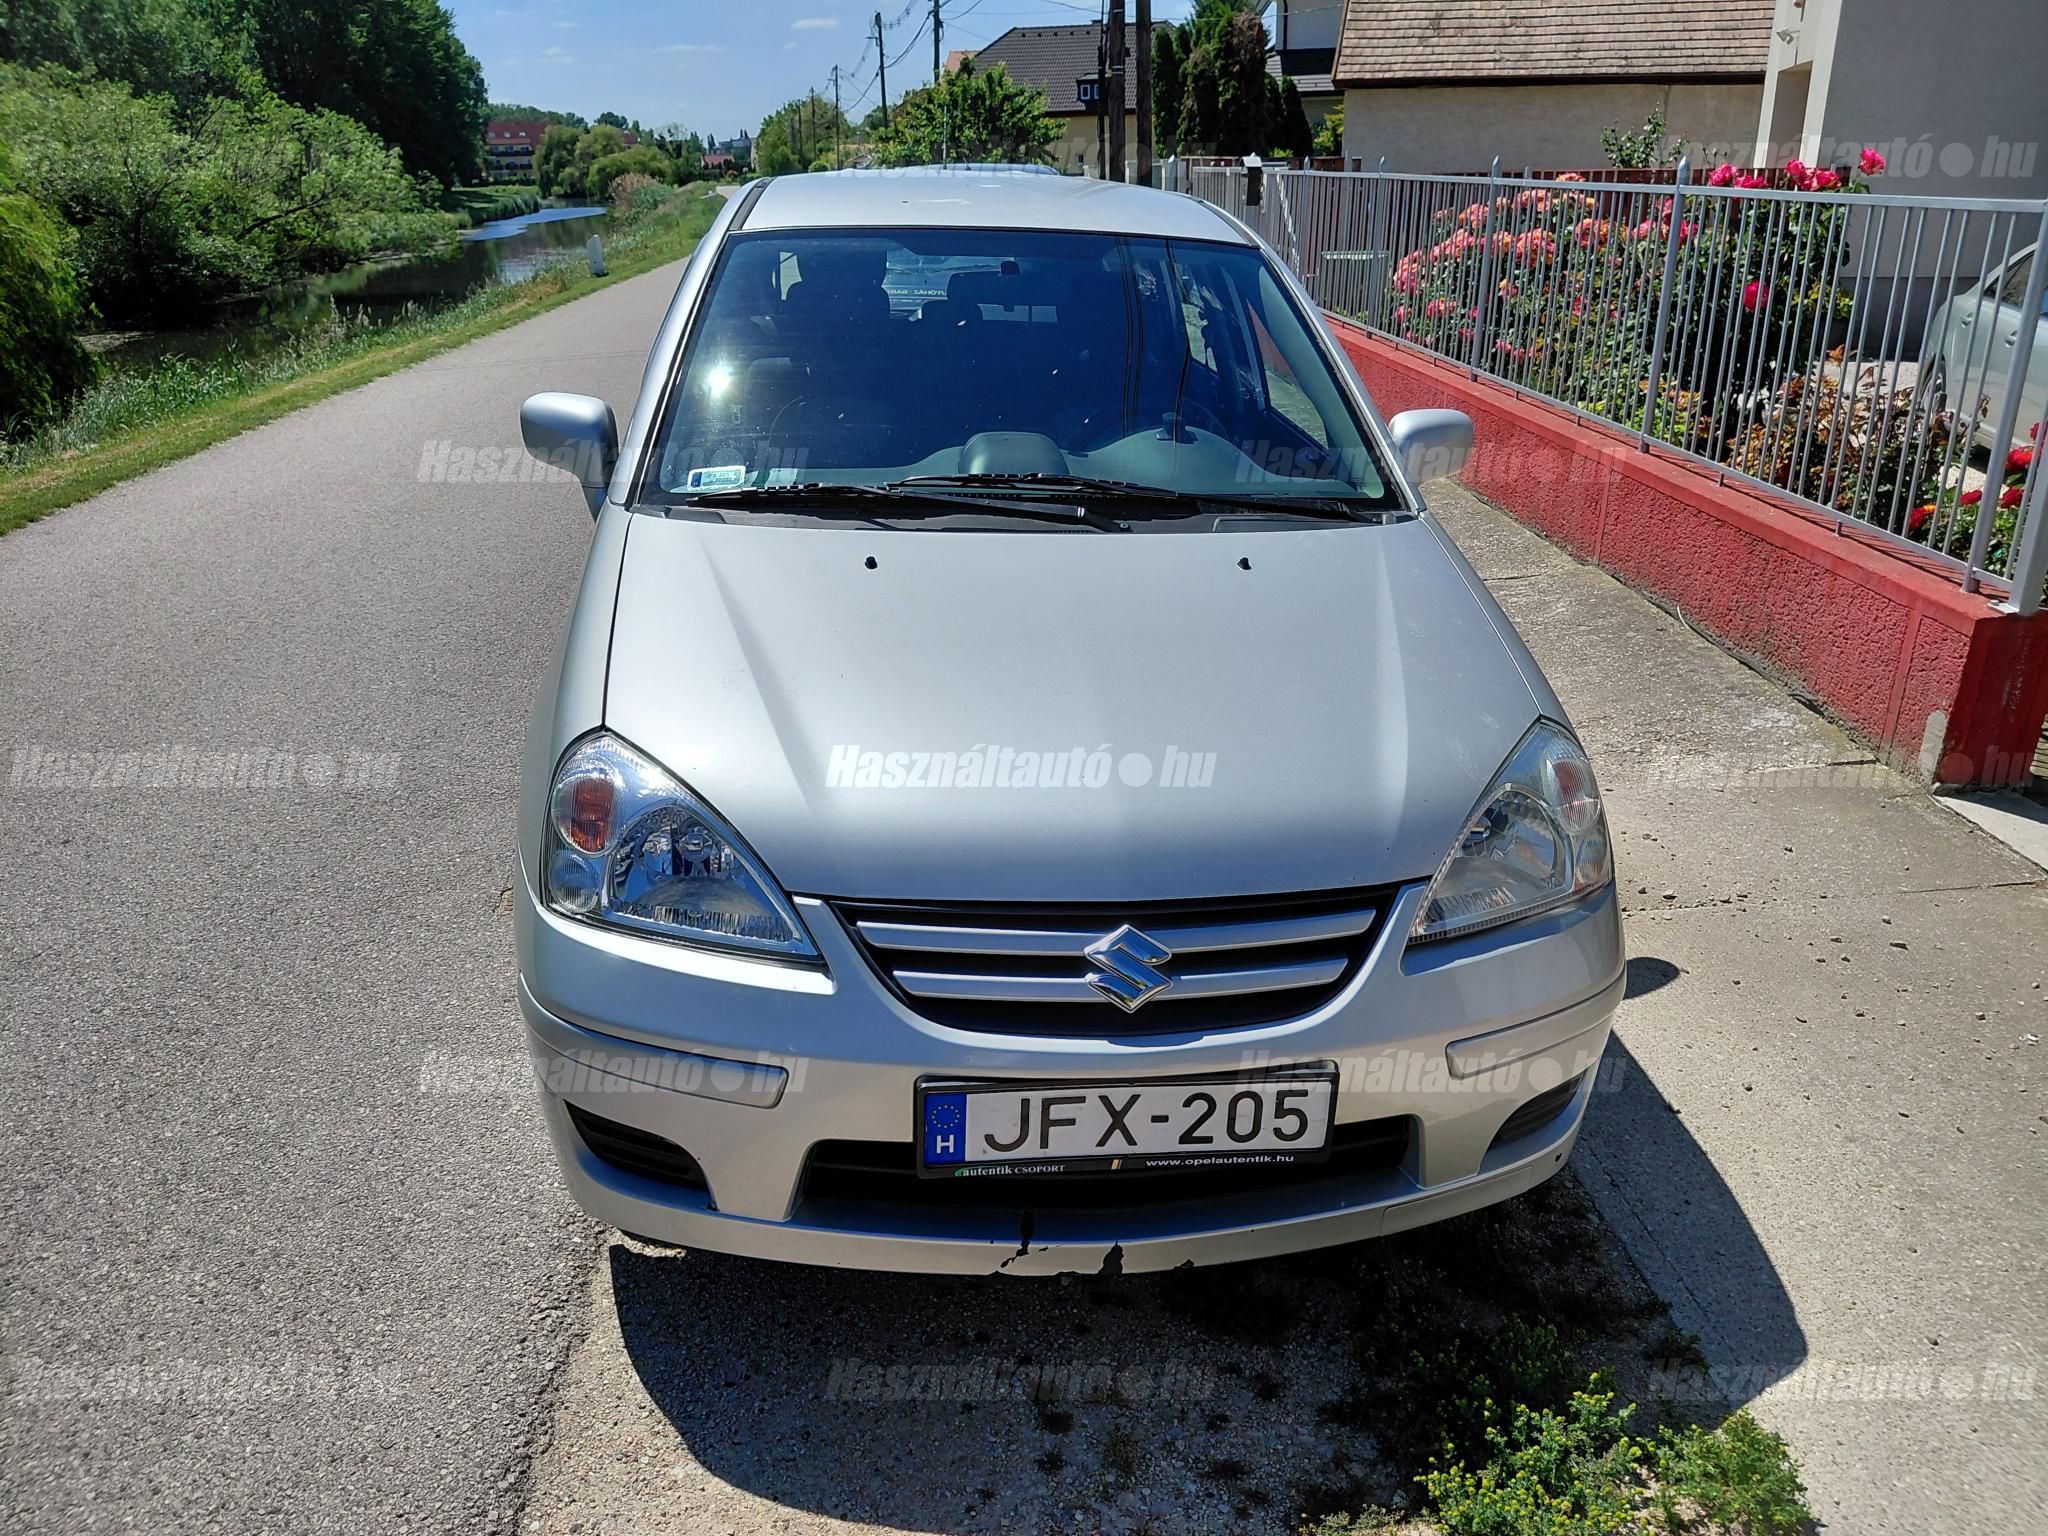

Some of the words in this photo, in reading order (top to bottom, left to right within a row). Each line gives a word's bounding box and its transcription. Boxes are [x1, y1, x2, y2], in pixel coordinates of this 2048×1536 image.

[984, 1089, 1309, 1153] JFX-205
[936, 1135, 954, 1154] H
[1146, 1153, 1294, 1167] www.opelautentik.hu
[1015, 1164, 1066, 1174] CSOPORT
